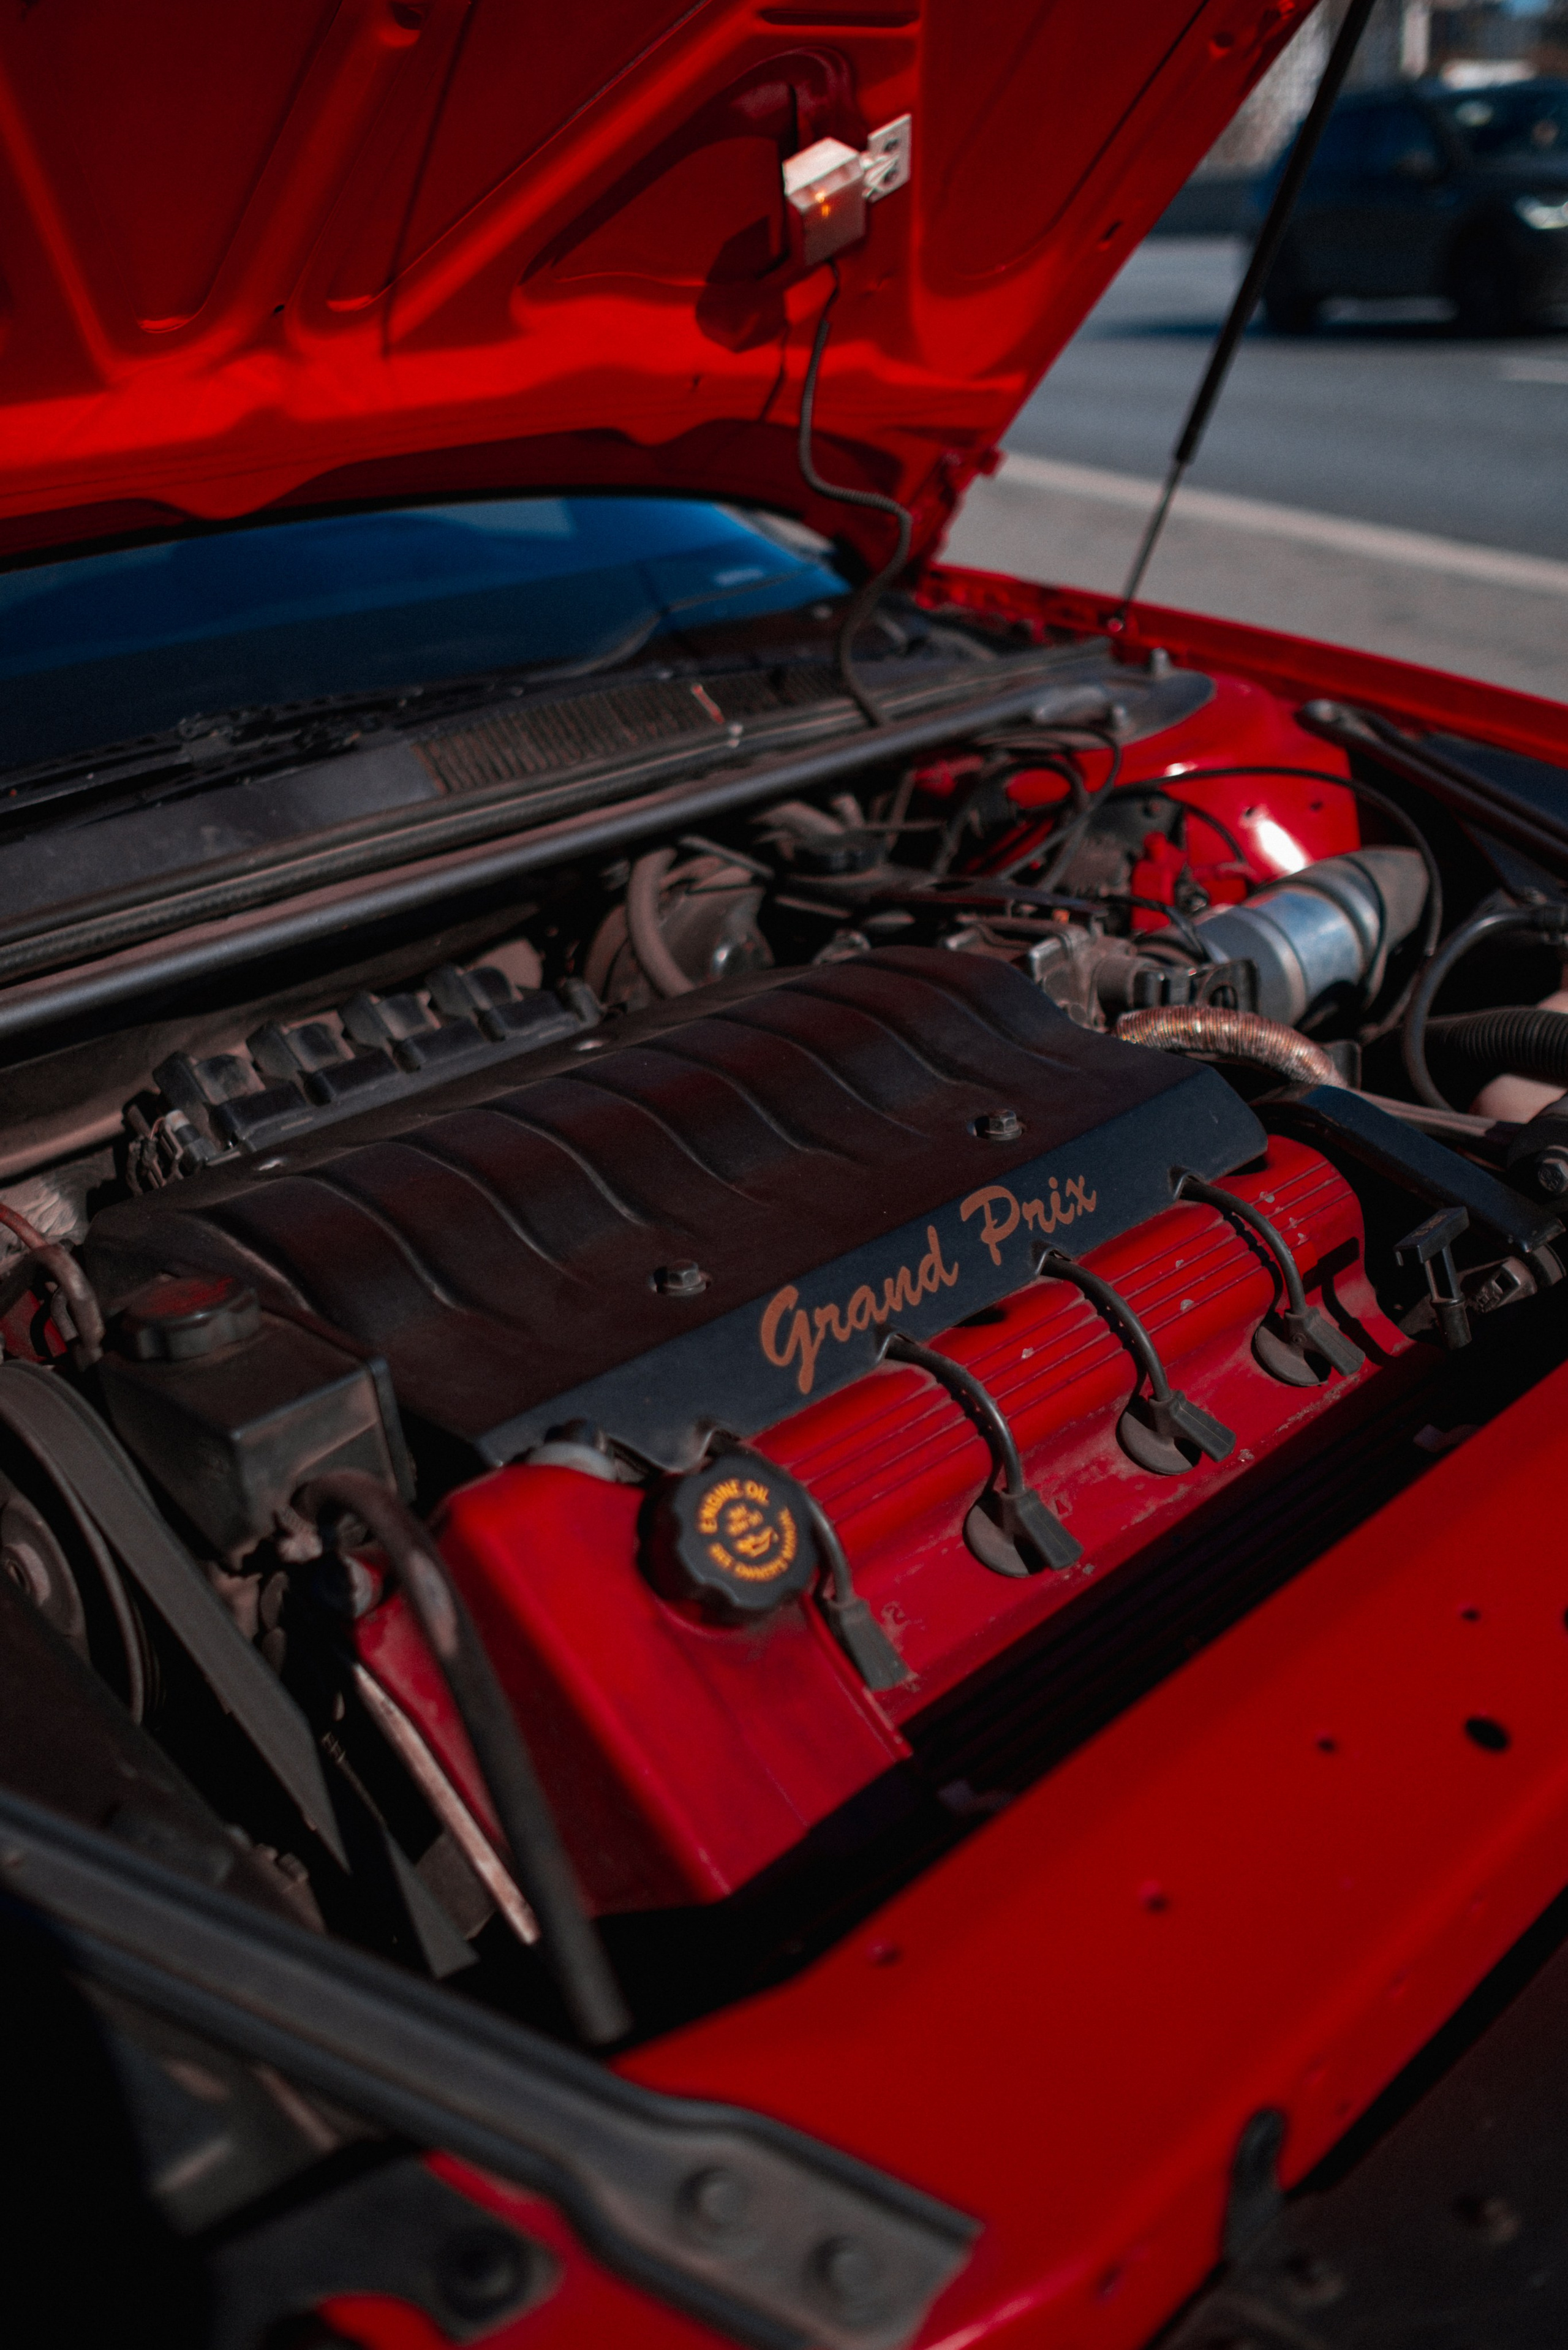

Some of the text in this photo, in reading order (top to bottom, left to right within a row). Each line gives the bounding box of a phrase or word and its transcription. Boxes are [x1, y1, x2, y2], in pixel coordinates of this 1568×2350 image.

[760, 1175, 1096, 1395] Grand Prix
[700, 1479, 744, 1533] ENGINE
[744, 1480, 769, 1506] OIL
